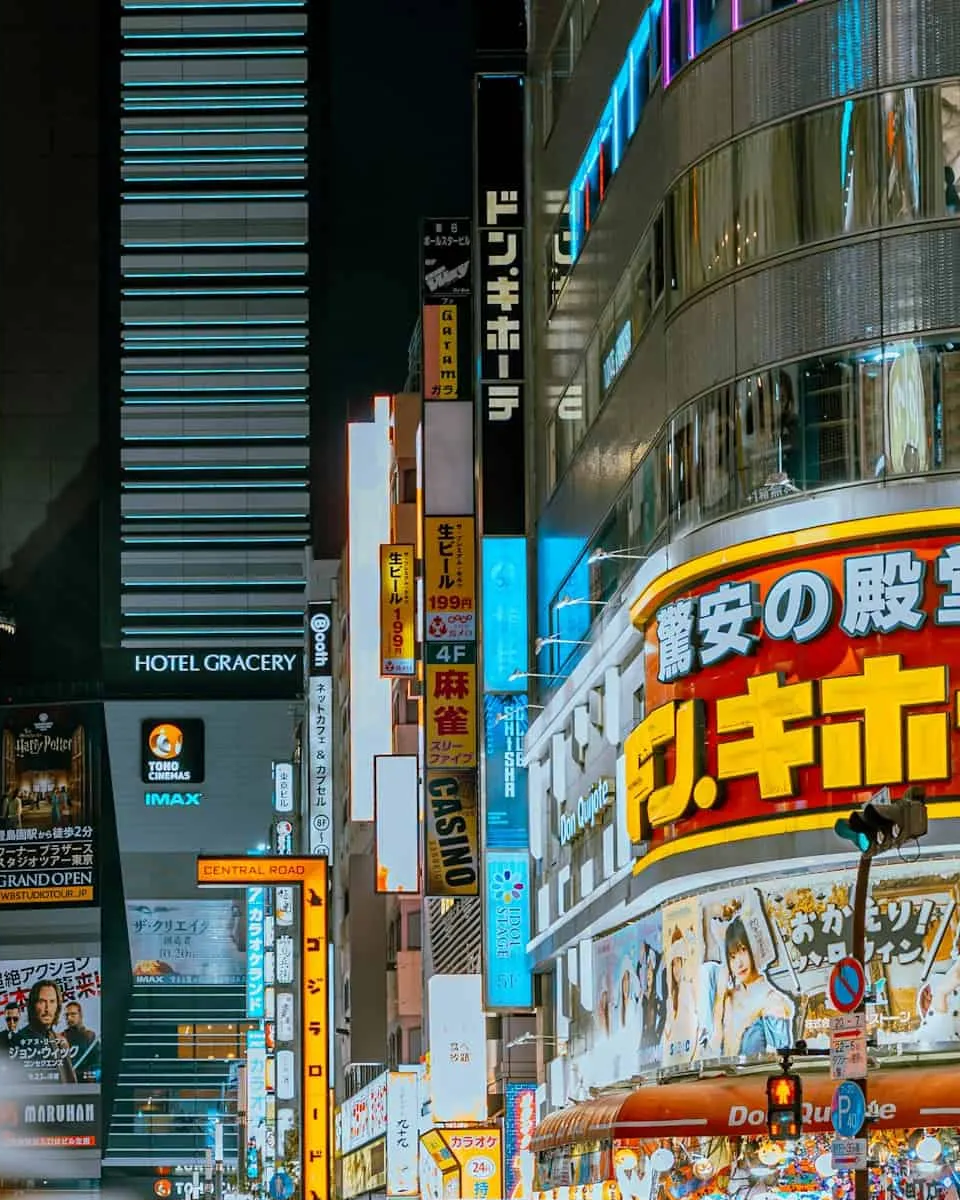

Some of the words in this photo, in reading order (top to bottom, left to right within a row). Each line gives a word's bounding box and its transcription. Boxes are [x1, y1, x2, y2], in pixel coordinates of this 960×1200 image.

[438, 523, 456, 590] 生ビール
[388, 551, 403, 605] 生ビール
[310, 612, 331, 667] Booth
[135, 654, 200, 672] HOTEL
[203, 654, 297, 672] GRACERY
[435, 645, 466, 662] 4F
[433, 668, 470, 737] 麻雀
[315, 683, 327, 744] ネットカフェ
[43, 735, 73, 753] Potter
[623, 654, 960, 844] ドン・キホ
[147, 761, 179, 771] TOHO
[147, 771, 191, 780] CINEMAS
[315, 765, 327, 807] カプセル
[144, 792, 201, 805] IMAX
[428, 776, 476, 887] CASINO
[51, 871, 93, 886] OPEN
[203, 864, 264, 876] CENTRAL
[270, 864, 306, 876] ROAD
[24, 1103, 95, 1123] MARUHAN
[838, 1094, 851, 1129] P
[450, 1135, 498, 1148] カラオケ
